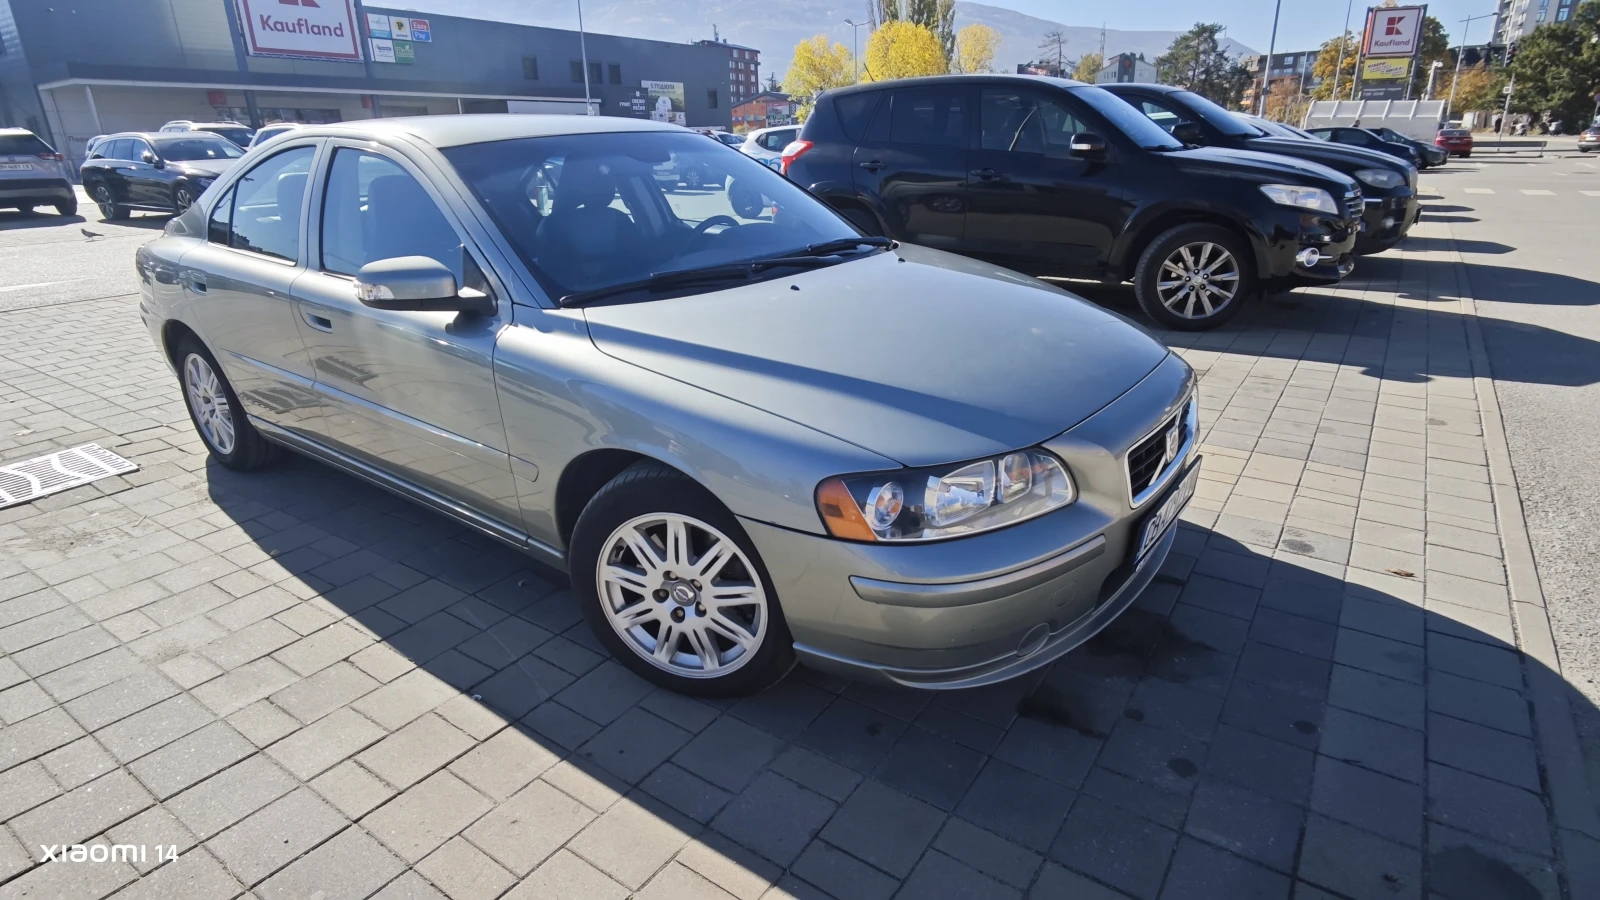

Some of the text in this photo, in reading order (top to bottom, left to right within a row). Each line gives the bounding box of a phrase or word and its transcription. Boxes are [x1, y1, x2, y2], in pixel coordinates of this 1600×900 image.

[260, 14, 344, 38] Kaufland
[415, 32, 425, 40] Pay
[1374, 39, 1410, 47] Kaufland
